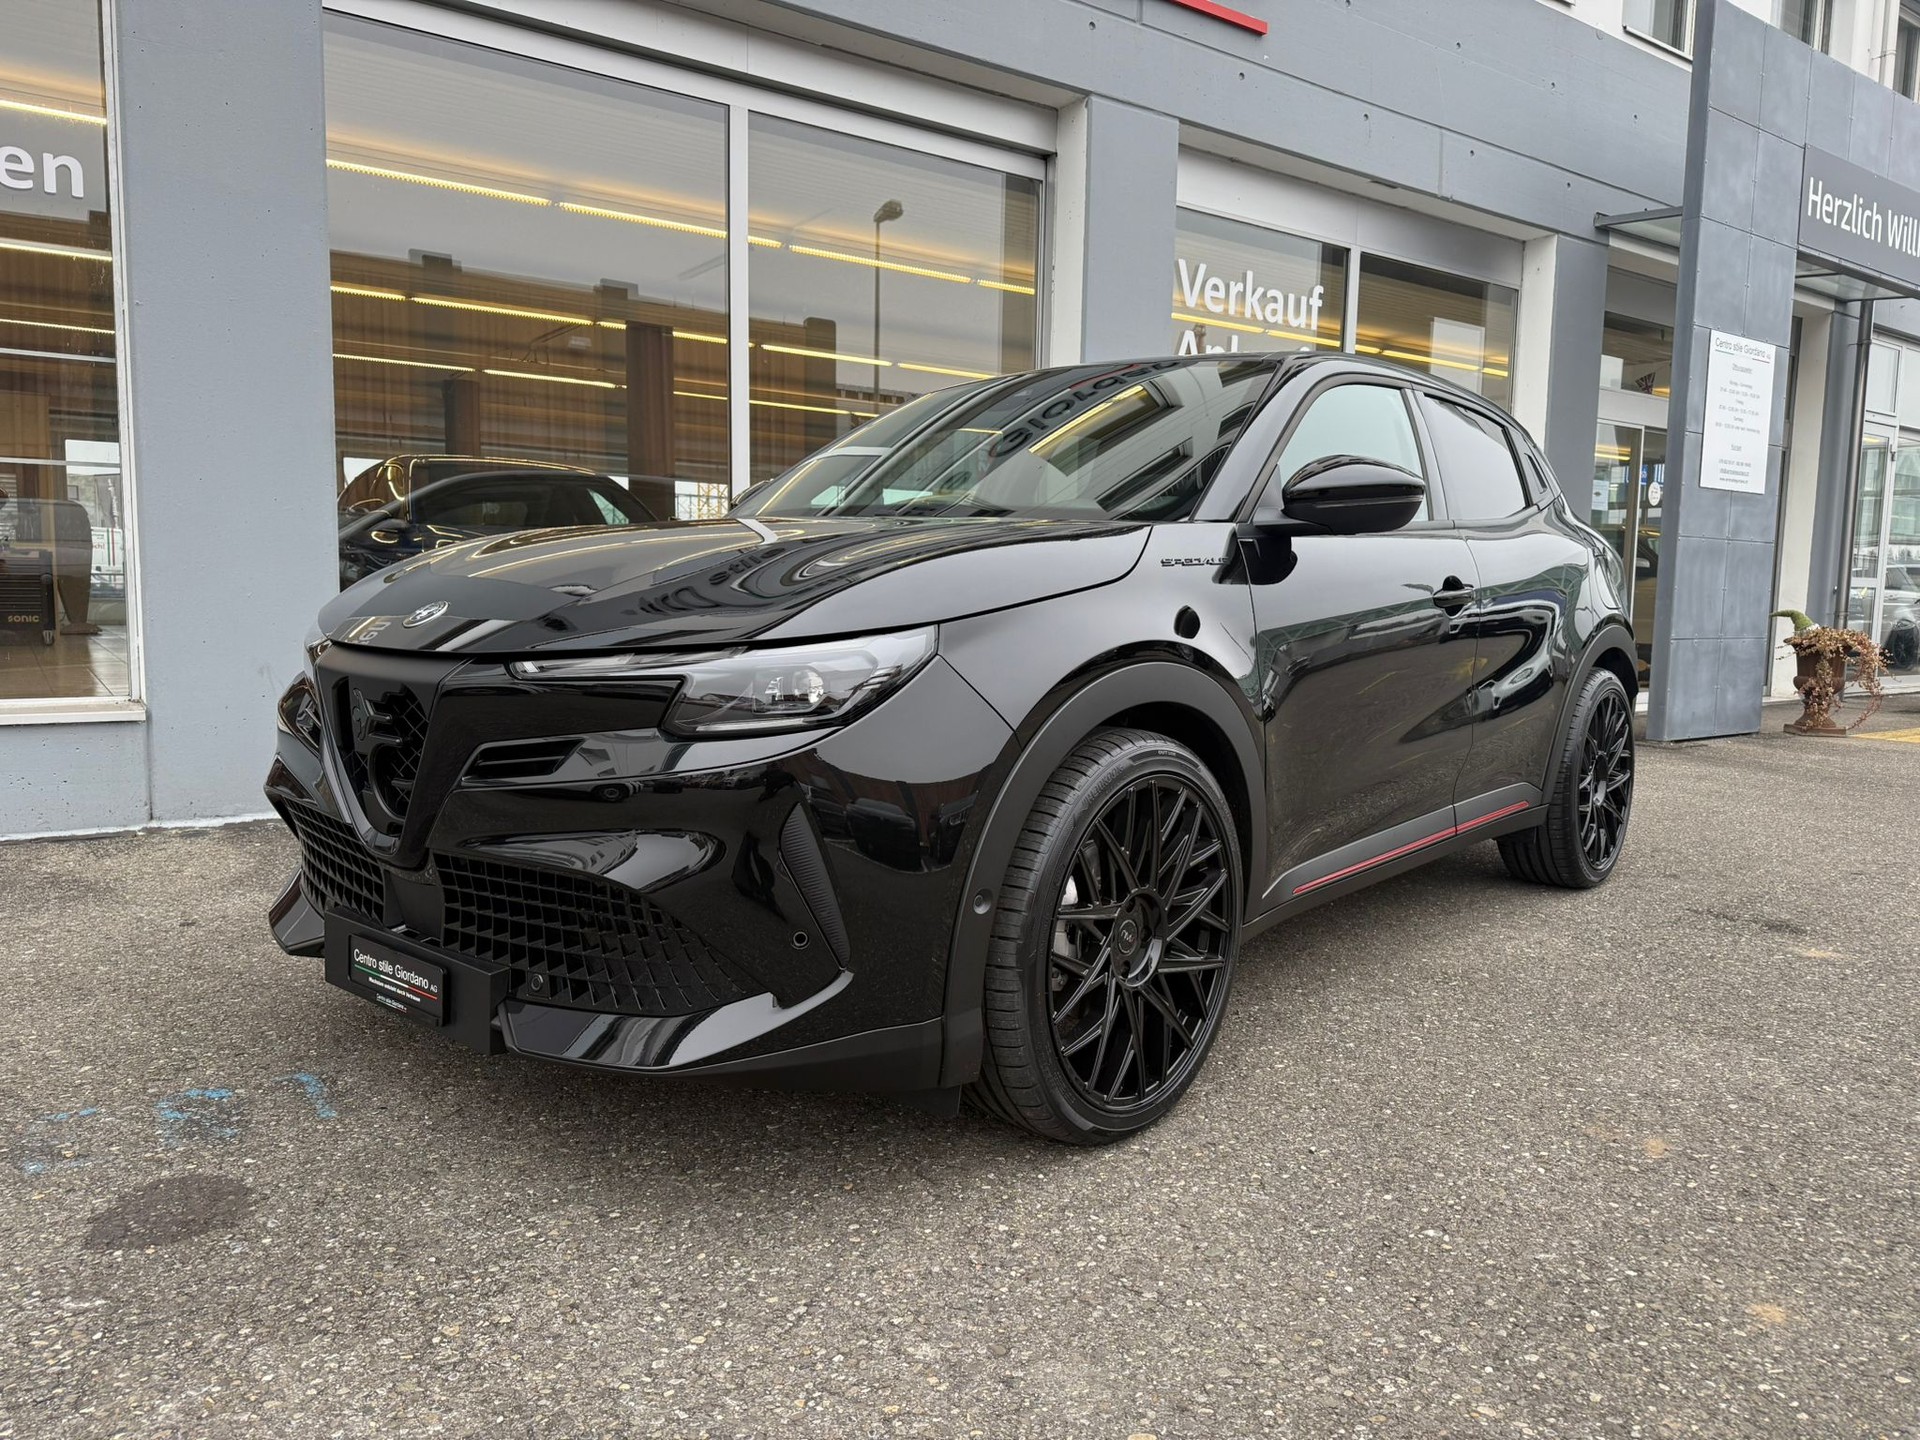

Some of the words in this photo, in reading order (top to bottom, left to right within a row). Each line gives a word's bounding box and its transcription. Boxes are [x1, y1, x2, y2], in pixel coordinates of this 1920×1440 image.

[1808, 177, 1882, 243] Herzlich
[1888, 209, 1920, 258] Will
[1178, 258, 1324, 331] Verkauf
[353, 948, 378, 969] Centro
[378, 960, 394, 975] stile
[394, 964, 429, 990] Giordano
[429, 984, 438, 993] AG
